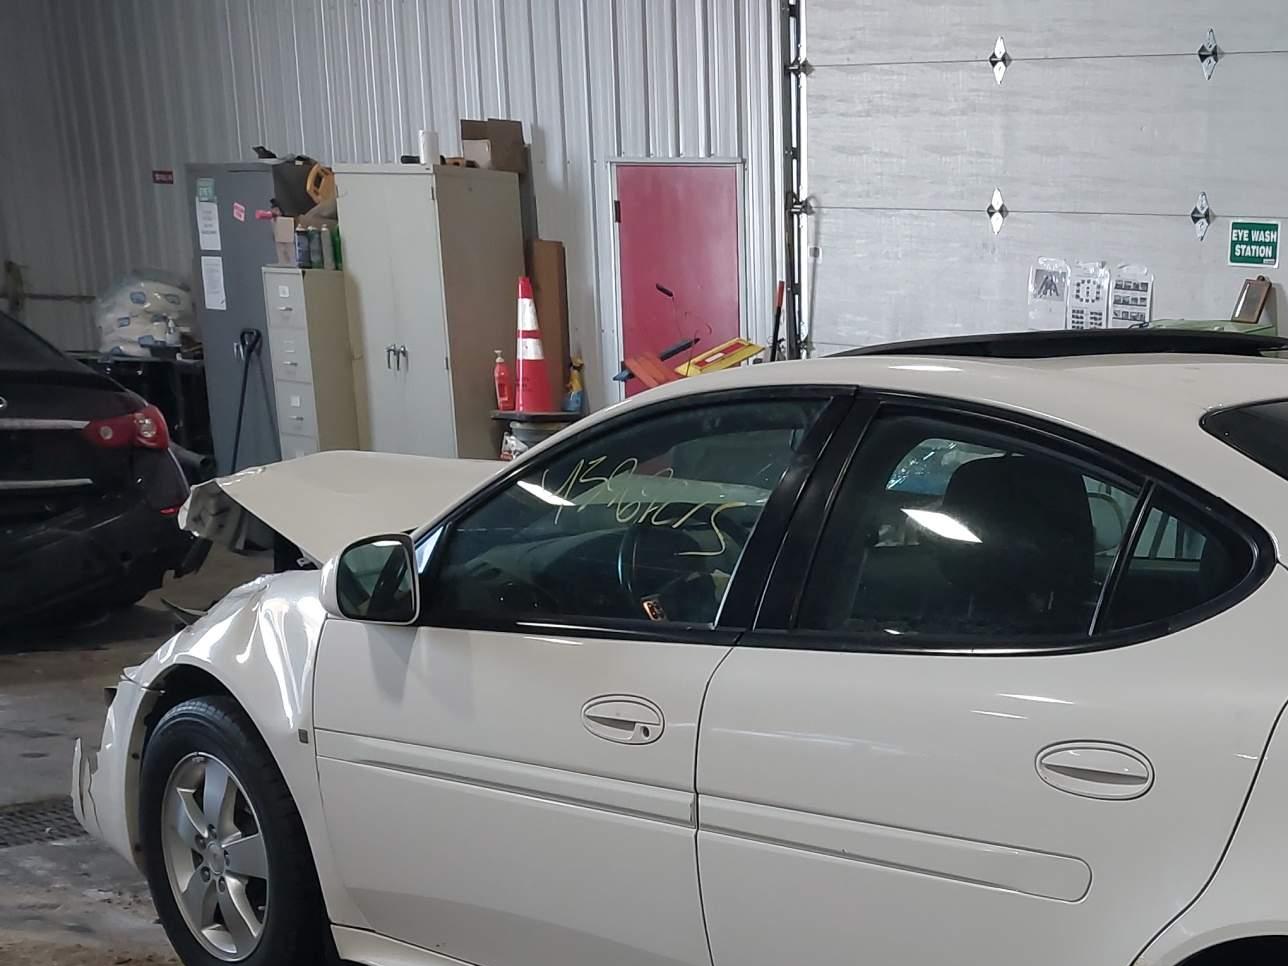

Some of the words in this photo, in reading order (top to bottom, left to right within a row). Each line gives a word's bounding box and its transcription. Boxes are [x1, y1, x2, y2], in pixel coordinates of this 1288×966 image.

[1232, 230, 1249, 241] EYE
[1251, 230, 1277, 242] WASH
[1235, 244, 1272, 258] STATION
